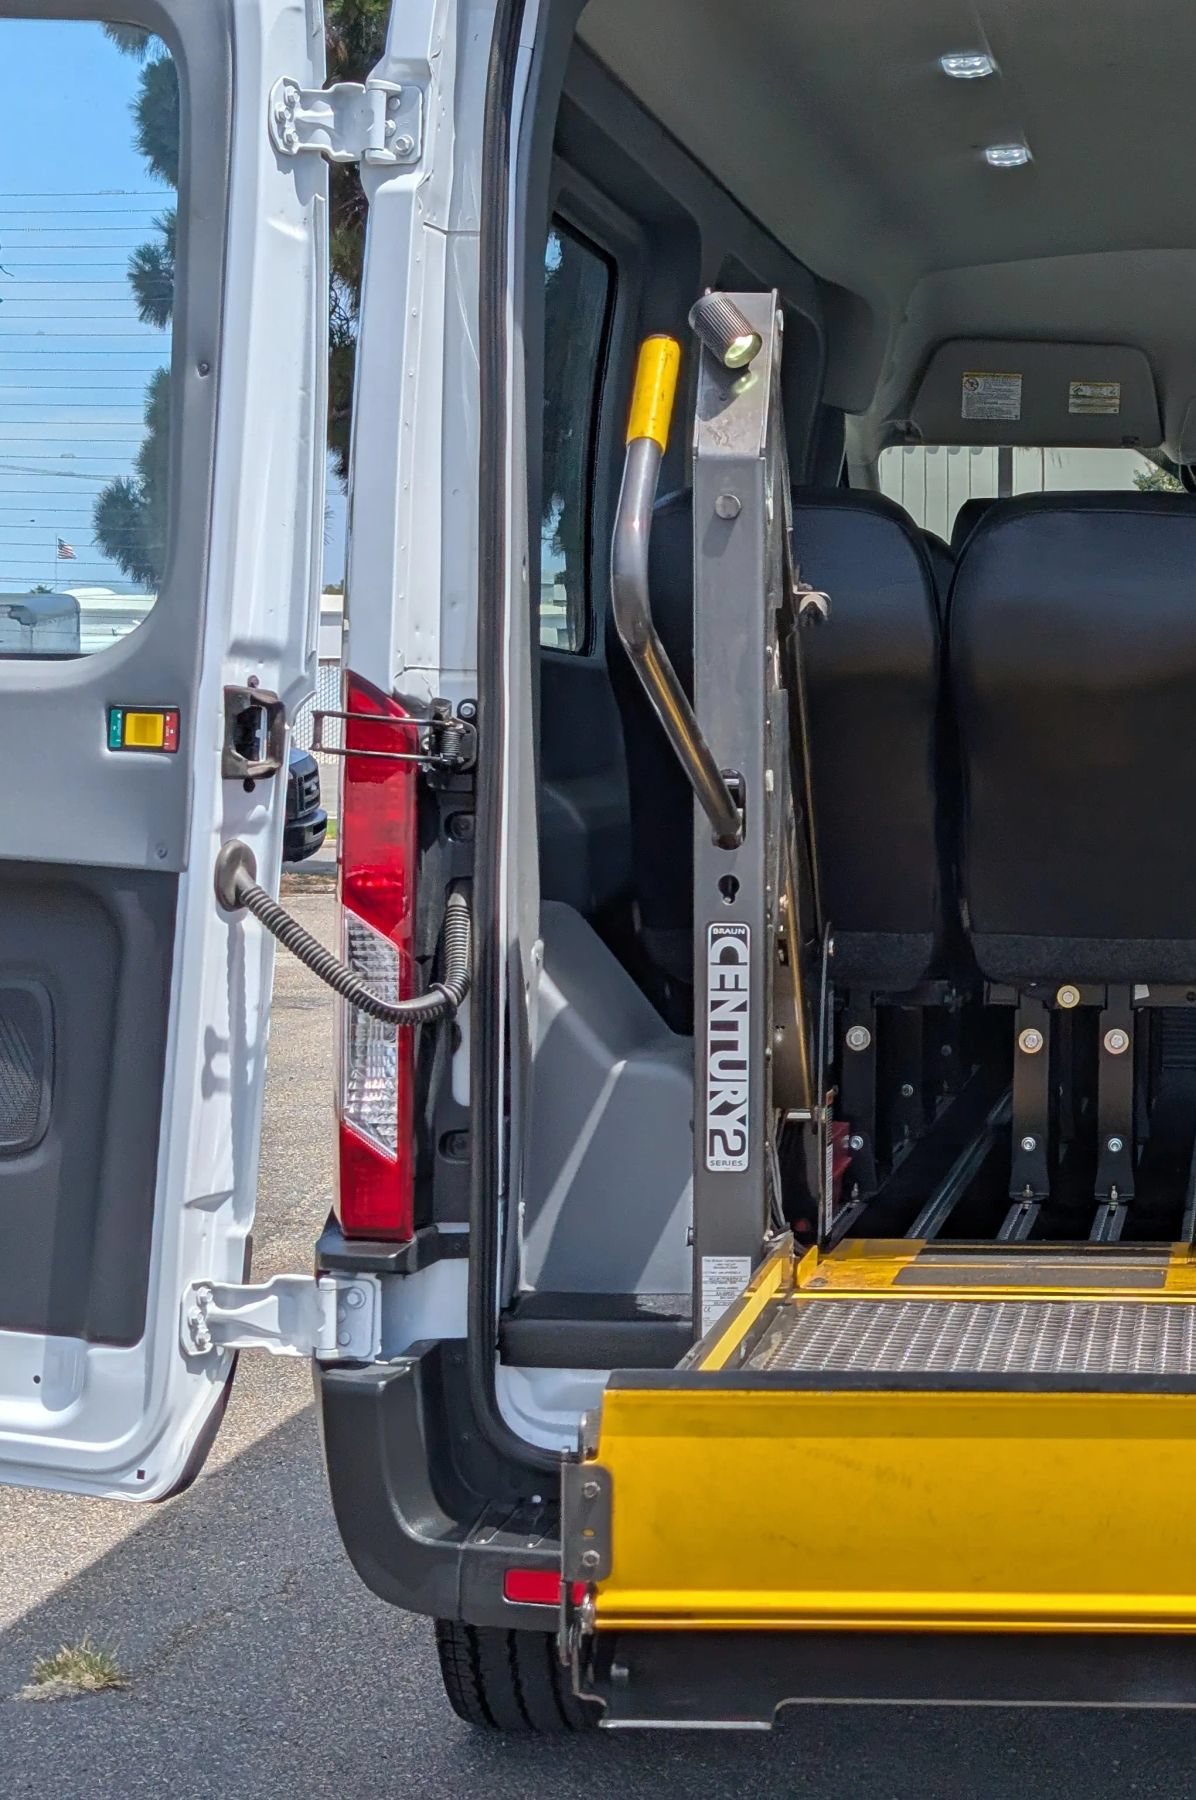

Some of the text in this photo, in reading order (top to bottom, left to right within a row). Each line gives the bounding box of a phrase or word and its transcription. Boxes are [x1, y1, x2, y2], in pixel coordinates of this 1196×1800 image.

[713, 927, 745, 936] BRAUN
[710, 936, 748, 1127] CENTURY
[709, 1159, 743, 1168] SERIES
